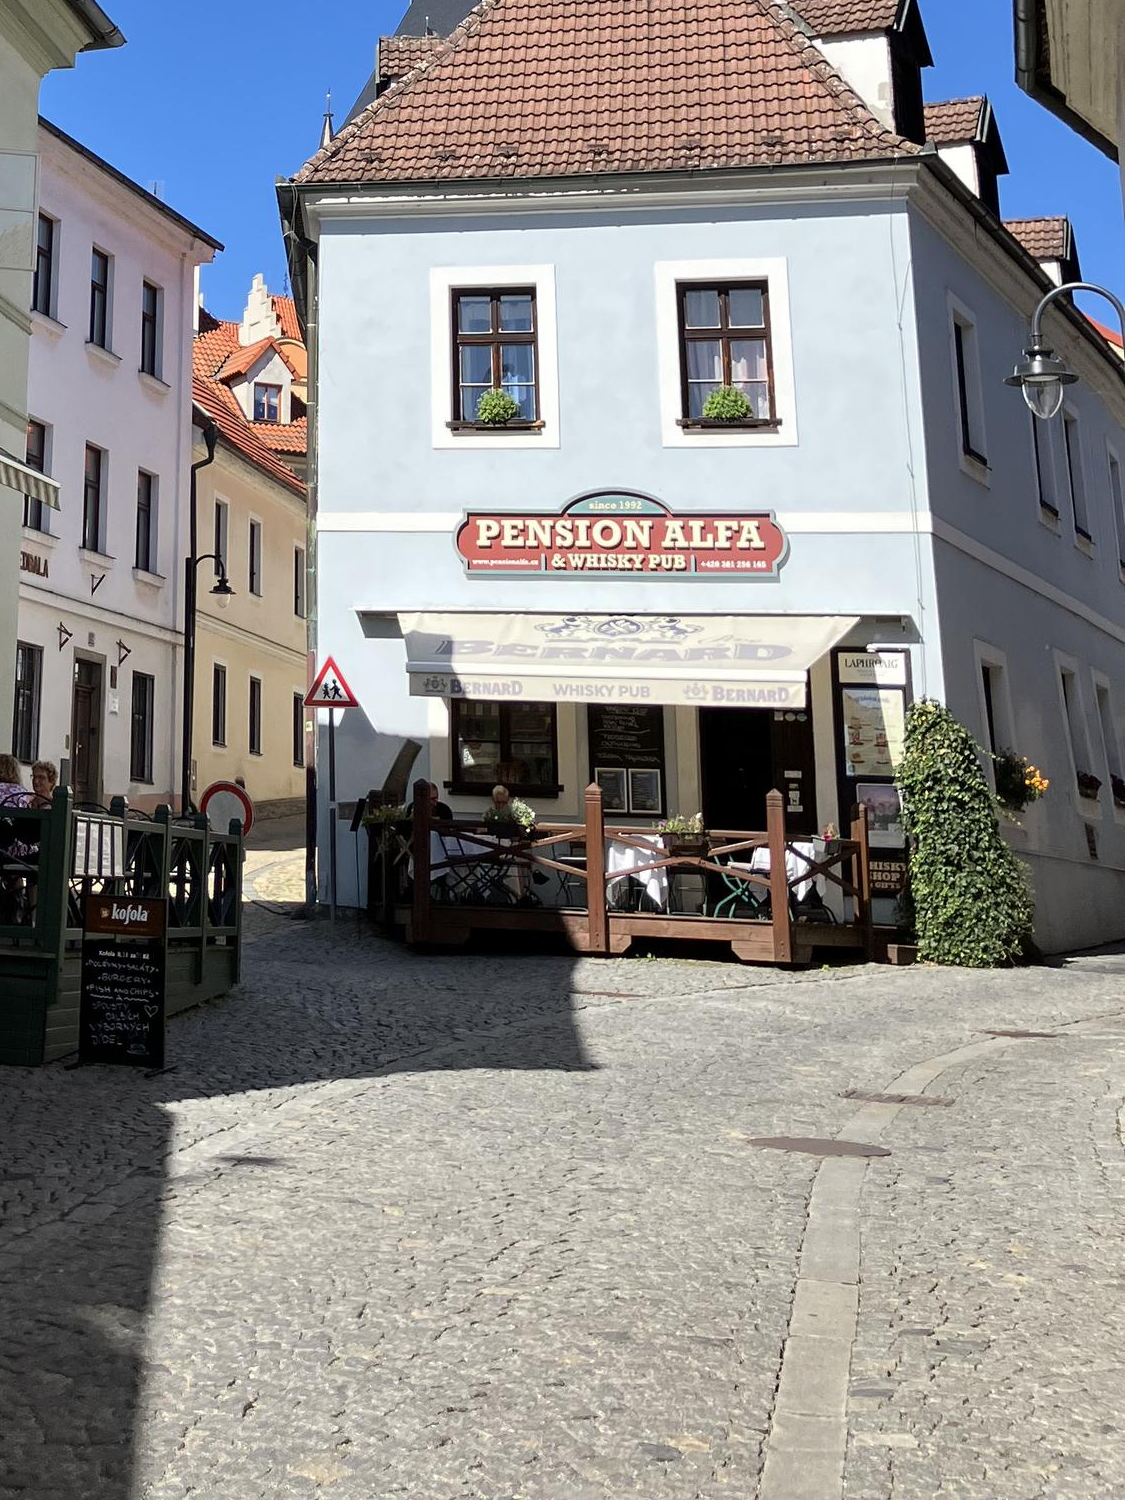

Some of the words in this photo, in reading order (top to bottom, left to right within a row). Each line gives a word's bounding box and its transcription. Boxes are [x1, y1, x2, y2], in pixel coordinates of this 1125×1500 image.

[588, 501, 616, 510] since
[620, 501, 642, 510] 1992
[476, 519, 654, 549] PENSION
[661, 520, 765, 550] ALFA
[551, 553, 566, 569] &
[568, 553, 644, 571] WHISKY
[648, 554, 686, 571] PUB
[435, 640, 793, 663] BERNARD
[845, 658, 898, 669] LAPHROAIG
[450, 678, 523, 696] BERNARD
[553, 683, 615, 698] WHISKY
[619, 684, 651, 699] PUB
[712, 685, 790, 703] BERNARD
[111, 903, 148, 925] kofola
